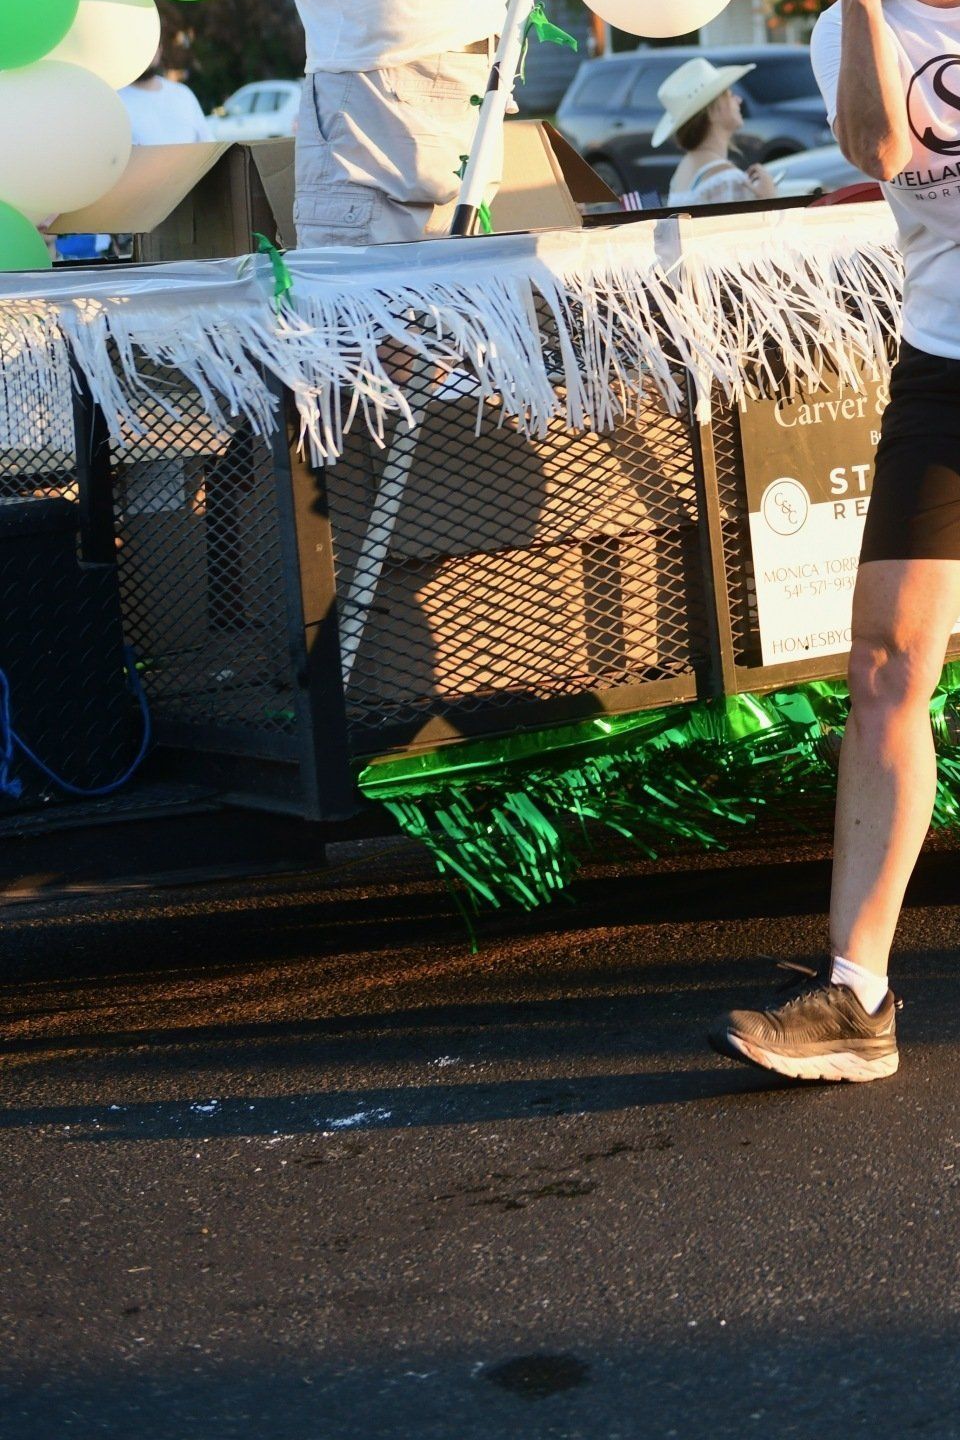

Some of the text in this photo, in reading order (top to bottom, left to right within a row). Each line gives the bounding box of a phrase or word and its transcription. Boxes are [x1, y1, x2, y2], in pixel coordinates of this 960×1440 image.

[774, 396, 868, 428] Carver
[763, 556, 859, 584] MONICA TORR
